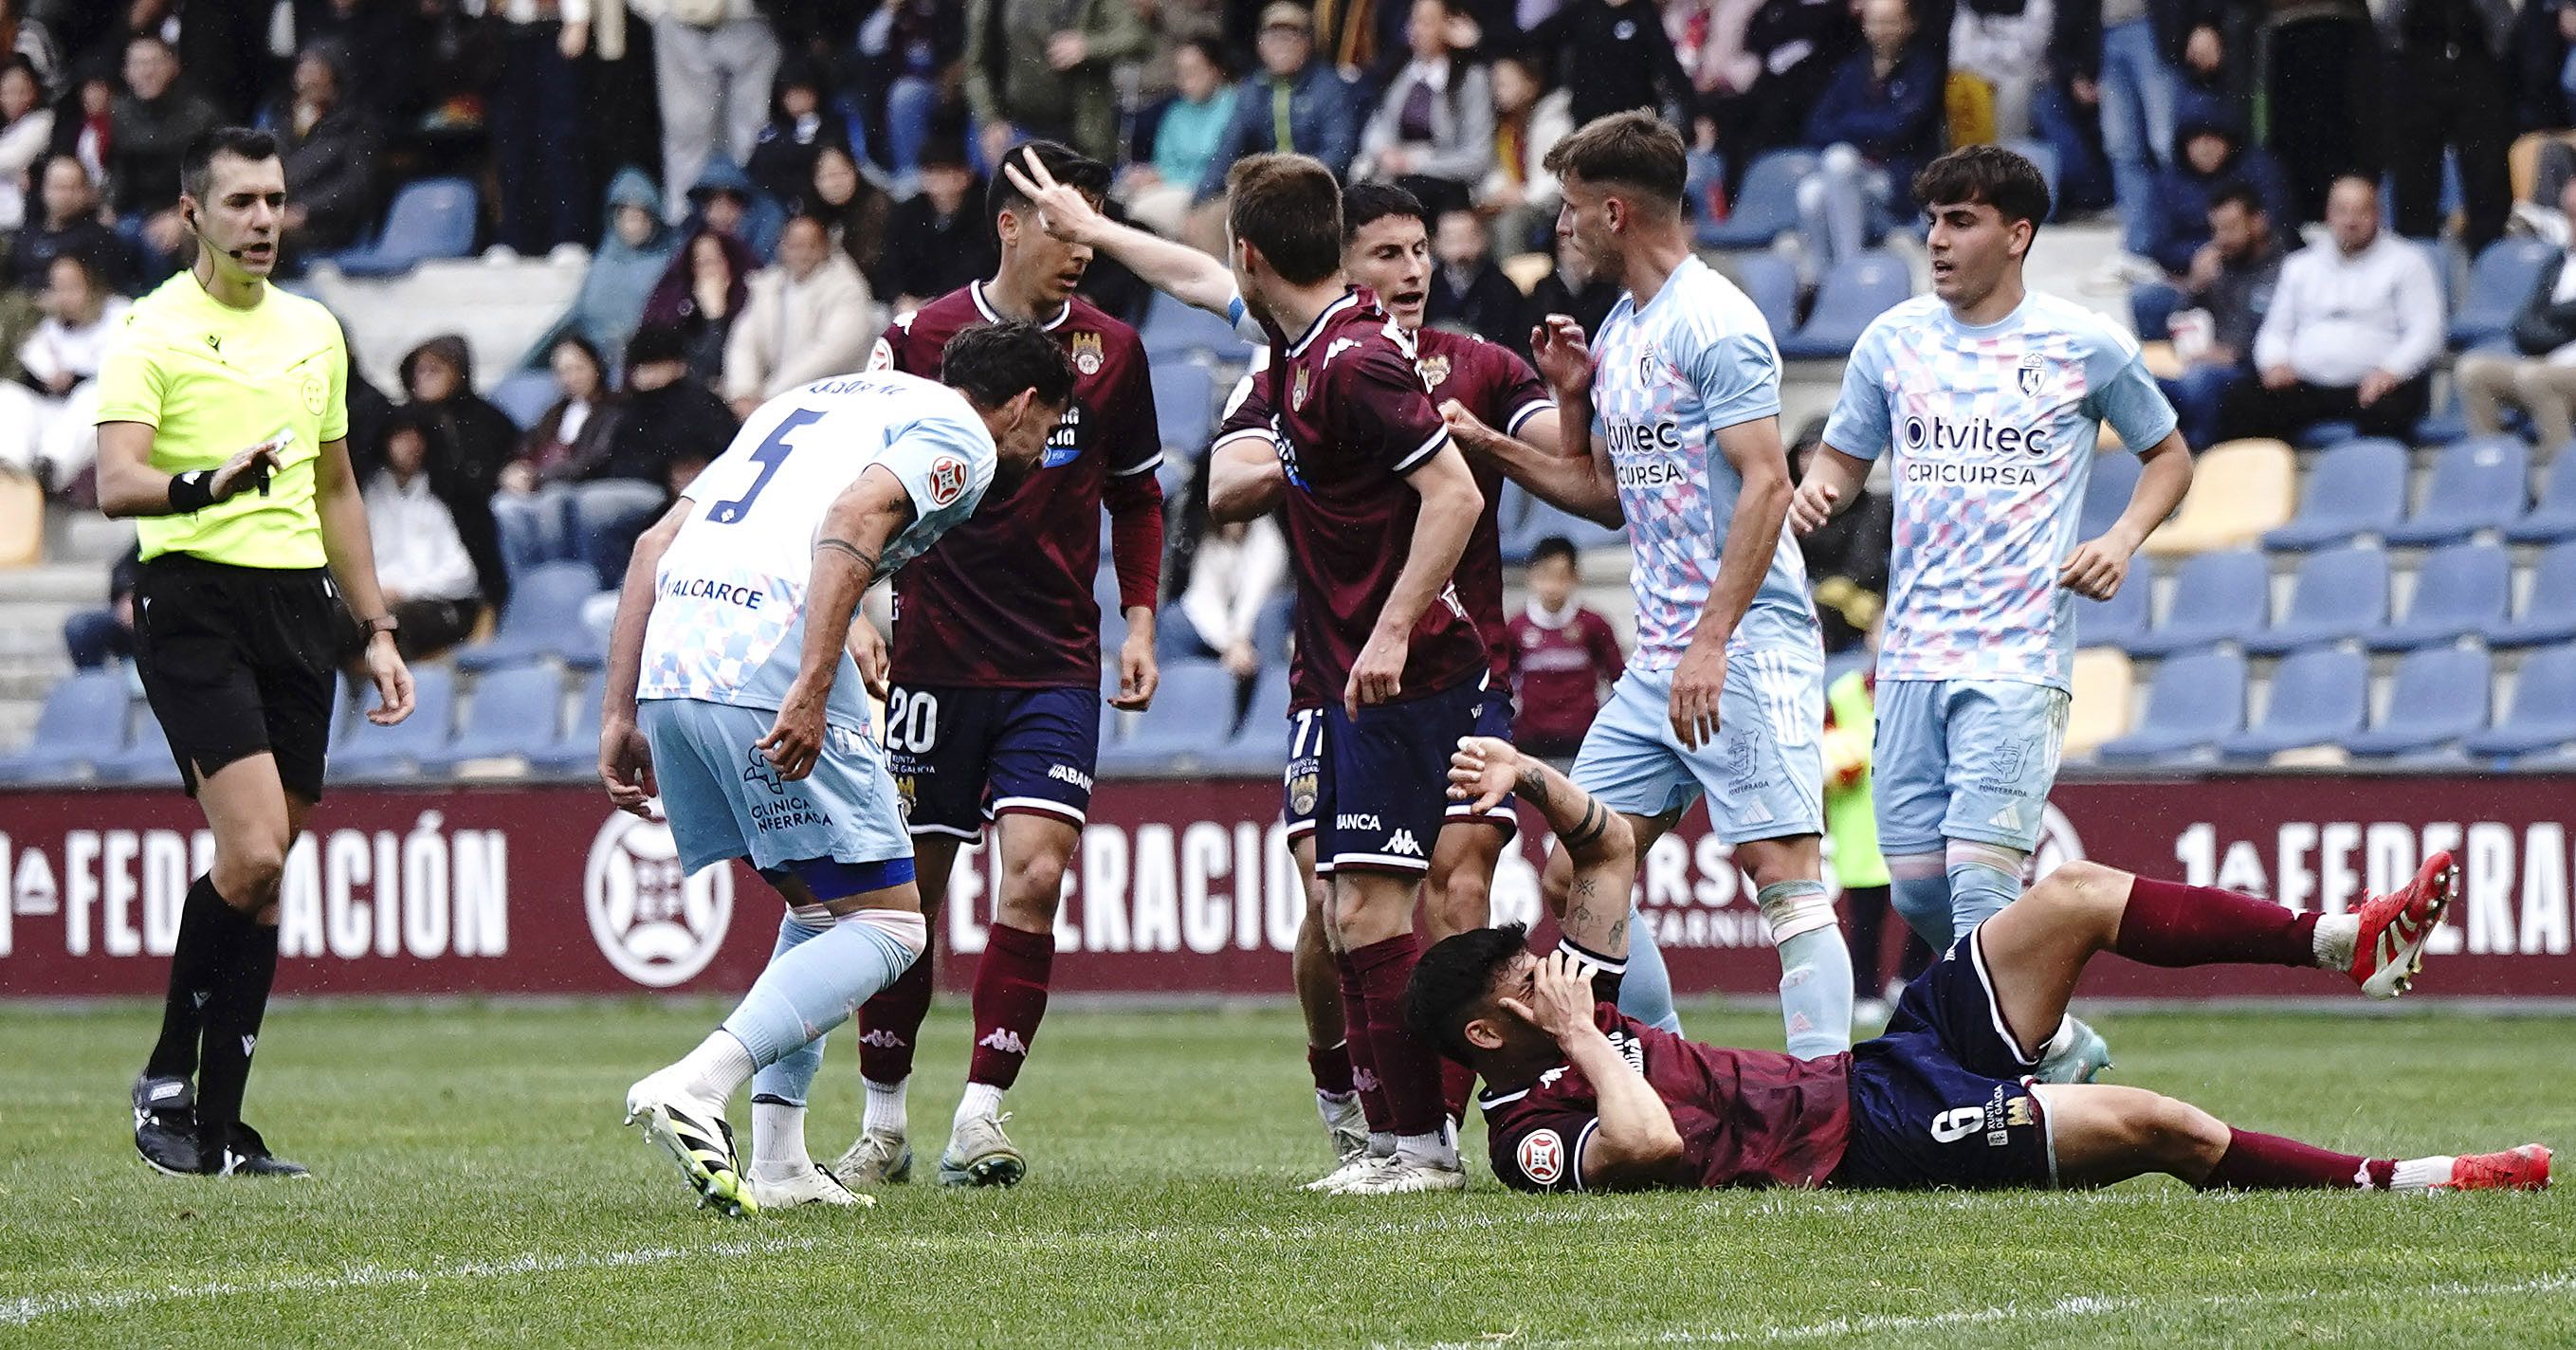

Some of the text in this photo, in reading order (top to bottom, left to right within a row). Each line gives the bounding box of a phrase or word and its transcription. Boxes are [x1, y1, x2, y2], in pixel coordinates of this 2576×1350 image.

[1605, 416, 1681, 451] tvitec
[1933, 416, 2048, 456] tvitec
[705, 408, 829, 524] 5
[1617, 462, 1684, 485] CURSA
[1907, 463, 2037, 487] CRICURSA
[886, 686, 939, 754] 20
[758, 812, 834, 834] NFERRADA
[64, 809, 509, 958] FEDACIÓN
[2277, 822, 2576, 956] FEDERA
